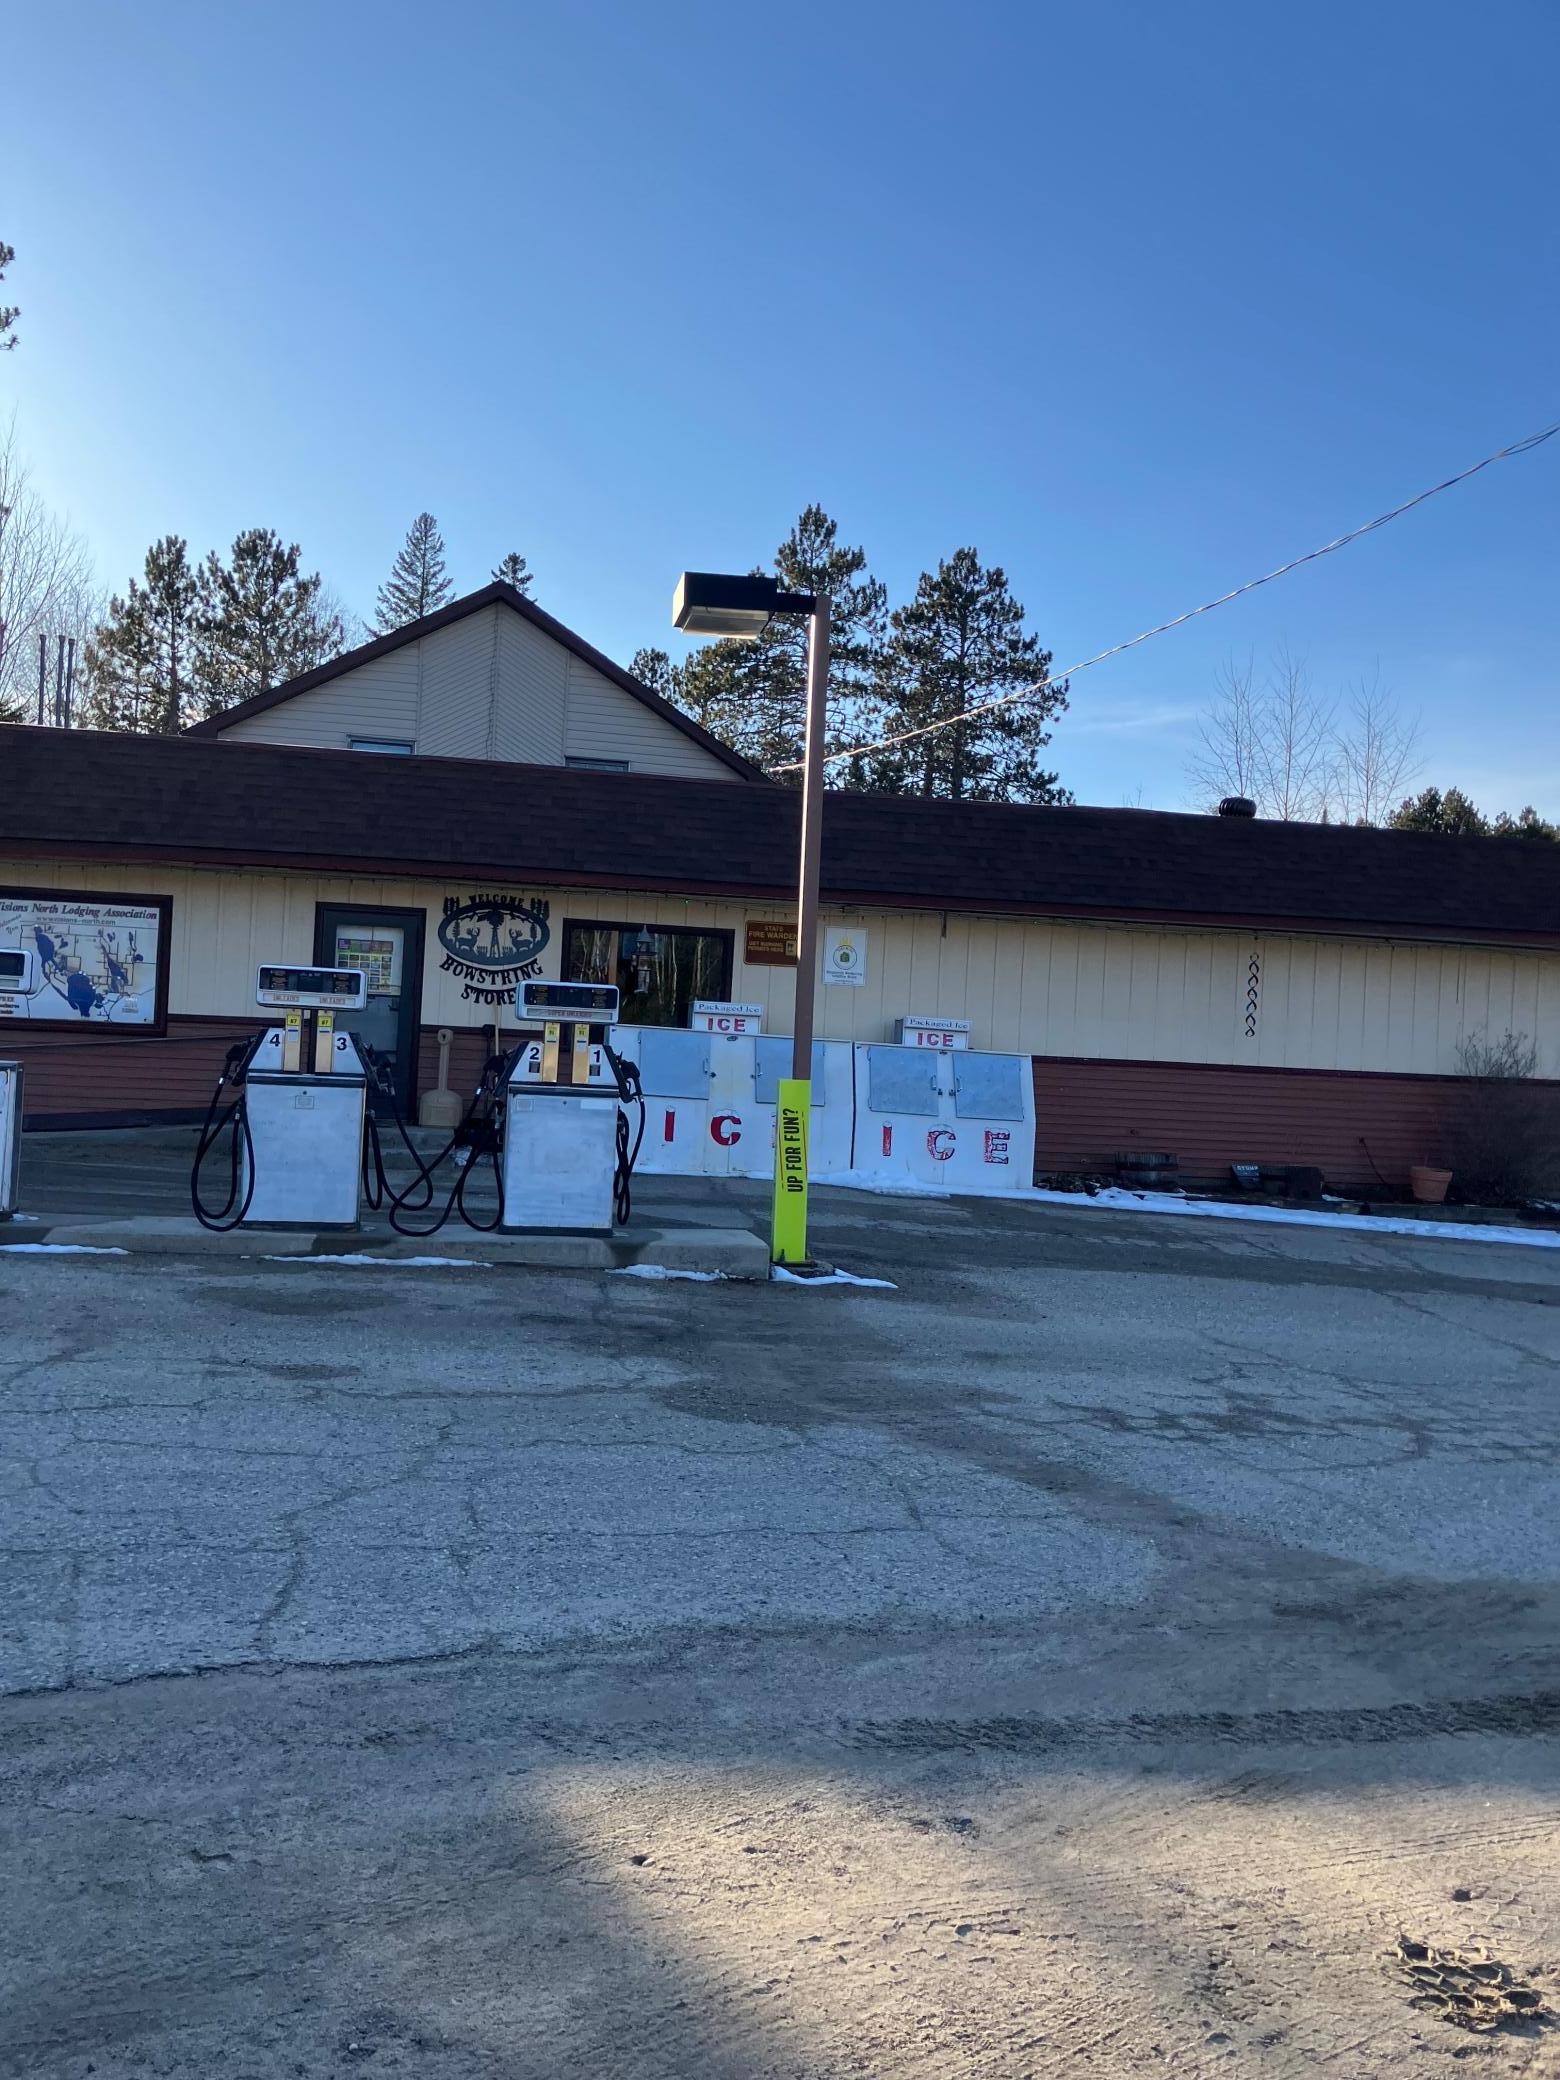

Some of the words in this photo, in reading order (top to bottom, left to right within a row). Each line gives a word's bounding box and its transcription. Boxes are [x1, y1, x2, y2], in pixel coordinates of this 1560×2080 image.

[468, 893, 525, 907] WELCOME
[31, 903, 59, 914] North
[61, 905, 101, 919] Lodging
[103, 907, 158, 920] Association
[748, 930, 766, 938] FIRE
[439, 952, 544, 986] BOWSTRING
[460, 983, 517, 1006] STORE
[698, 1003, 743, 1013] Packaged
[707, 1017, 746, 1033] ICE
[910, 1019, 952, 1029] Packaged
[269, 1034, 281, 1047] 4
[336, 1037, 347, 1051] 3
[917, 1032, 954, 1047] ICE
[529, 1047, 540, 1060] 2
[593, 1049, 601, 1063] 1
[782, 1108, 801, 1141] FUN?
[882, 1121, 1011, 1165] ICE
[785, 1146, 802, 1170] FOR
[787, 1175, 803, 1192] UP
